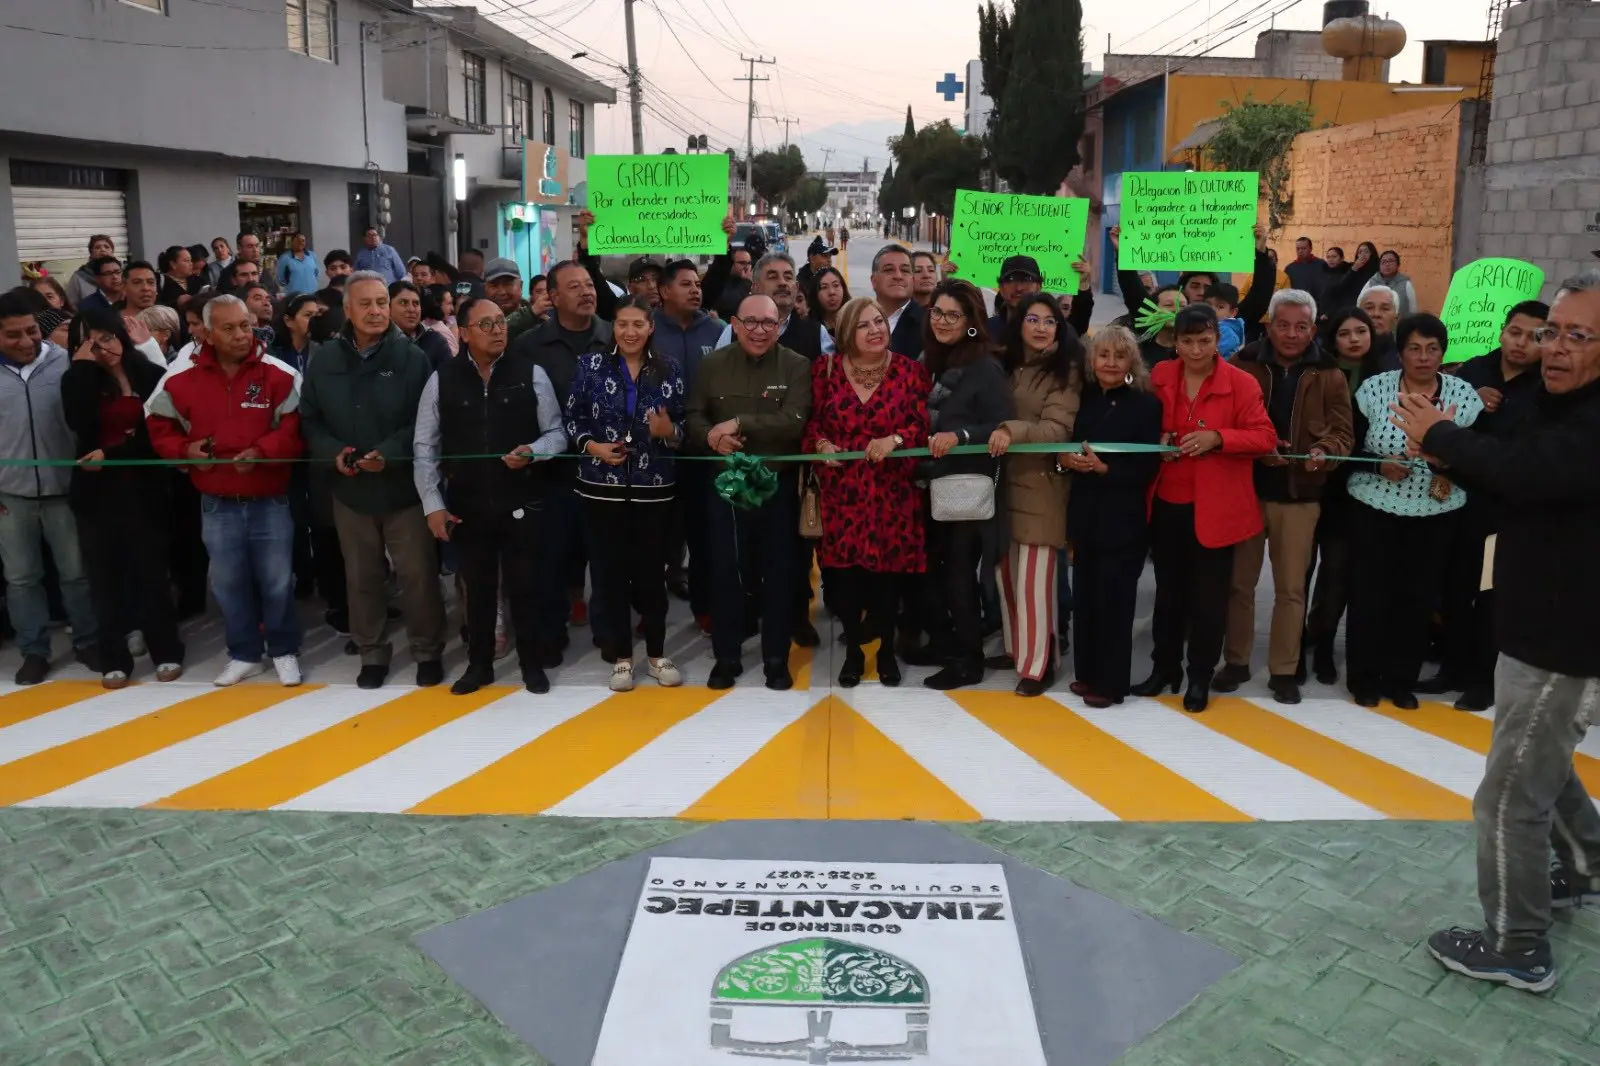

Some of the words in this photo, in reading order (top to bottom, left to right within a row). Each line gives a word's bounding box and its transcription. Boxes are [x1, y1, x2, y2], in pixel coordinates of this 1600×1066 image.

[617, 161, 690, 188] GRACIAS
[1200, 179, 1246, 194] CULTURAS
[592, 190, 614, 209] Por
[622, 191, 668, 207] atender
[674, 189, 721, 205] nuestras
[1135, 199, 1143, 213] le
[1146, 201, 1185, 217] agradece
[1201, 198, 1254, 215] trabajadores
[638, 209, 698, 221] necesidades
[1128, 218, 1135, 229] y
[1180, 214, 1218, 226] Gerardo
[1222, 217, 1237, 231] por
[665, 225, 712, 244] Culturas
[967, 221, 1016, 242] Gracias
[1021, 232, 1041, 247] por
[1140, 232, 1151, 241] su
[1155, 231, 1177, 244] gran
[1183, 227, 1216, 242] trabajo
[977, 242, 1018, 256] proteger
[1026, 240, 1063, 253] nuestro
[1466, 263, 1534, 295] GRACIAS
[1469, 292, 1495, 313] esta
[1466, 320, 1492, 334] para
[651, 878, 828, 890] AVANZANDO
[643, 896, 1006, 920] ZINACANTEPEC
